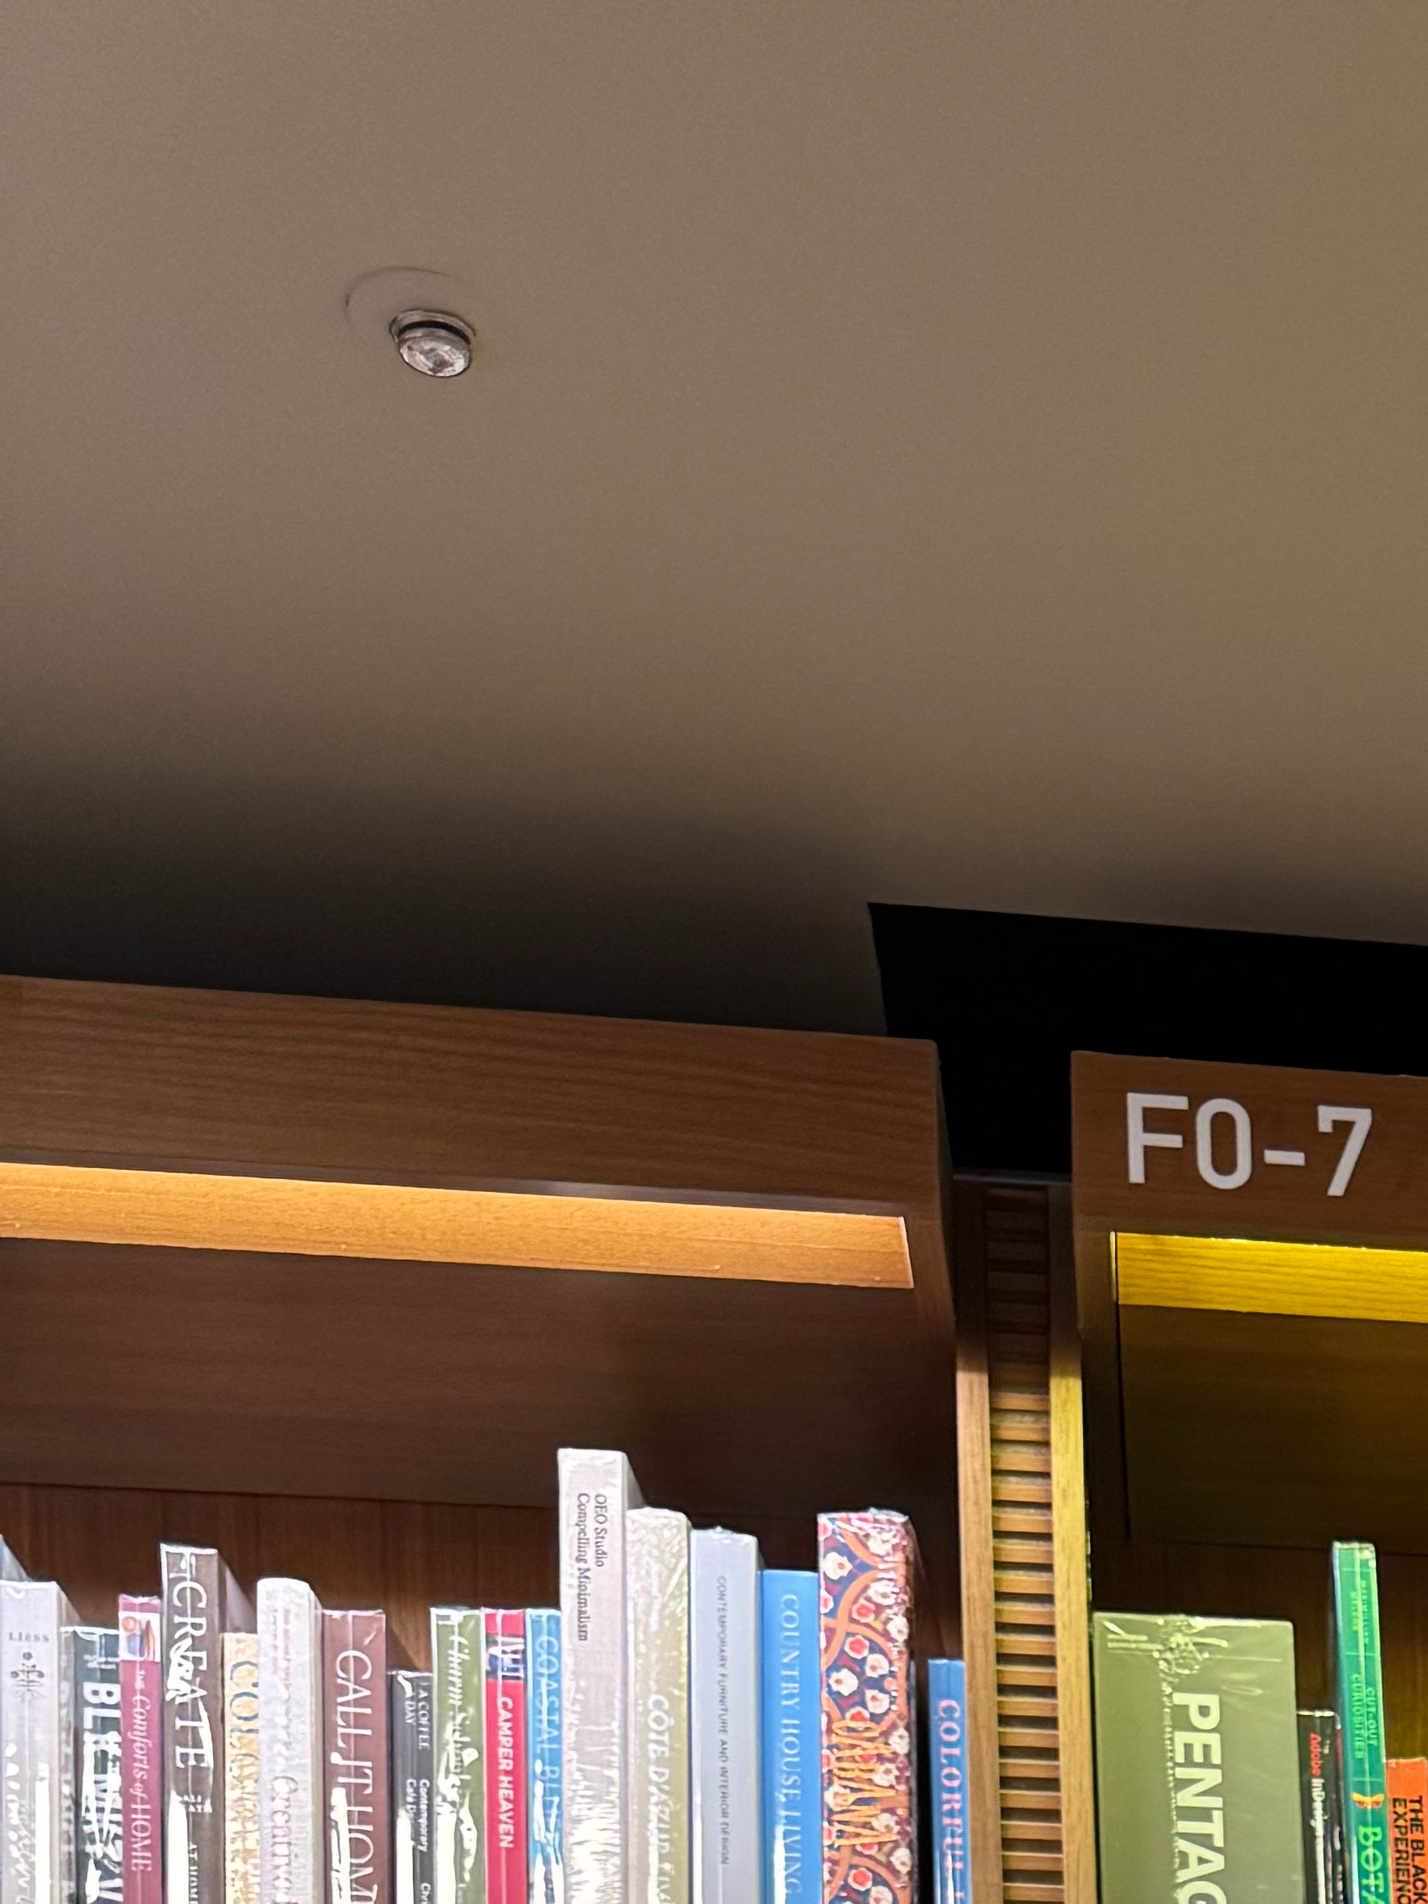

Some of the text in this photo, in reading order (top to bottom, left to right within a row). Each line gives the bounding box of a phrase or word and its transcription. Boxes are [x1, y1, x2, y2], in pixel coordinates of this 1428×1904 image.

[1125, 1091, 1373, 1197] F0-7
[577, 1492, 590, 1642] Compelling Minimalism
[172, 1579, 211, 1769] CREATE
[498, 1696, 514, 1849] CAMPER HEAVEN
[1408, 1796, 1428, 1904] THE BLACK
